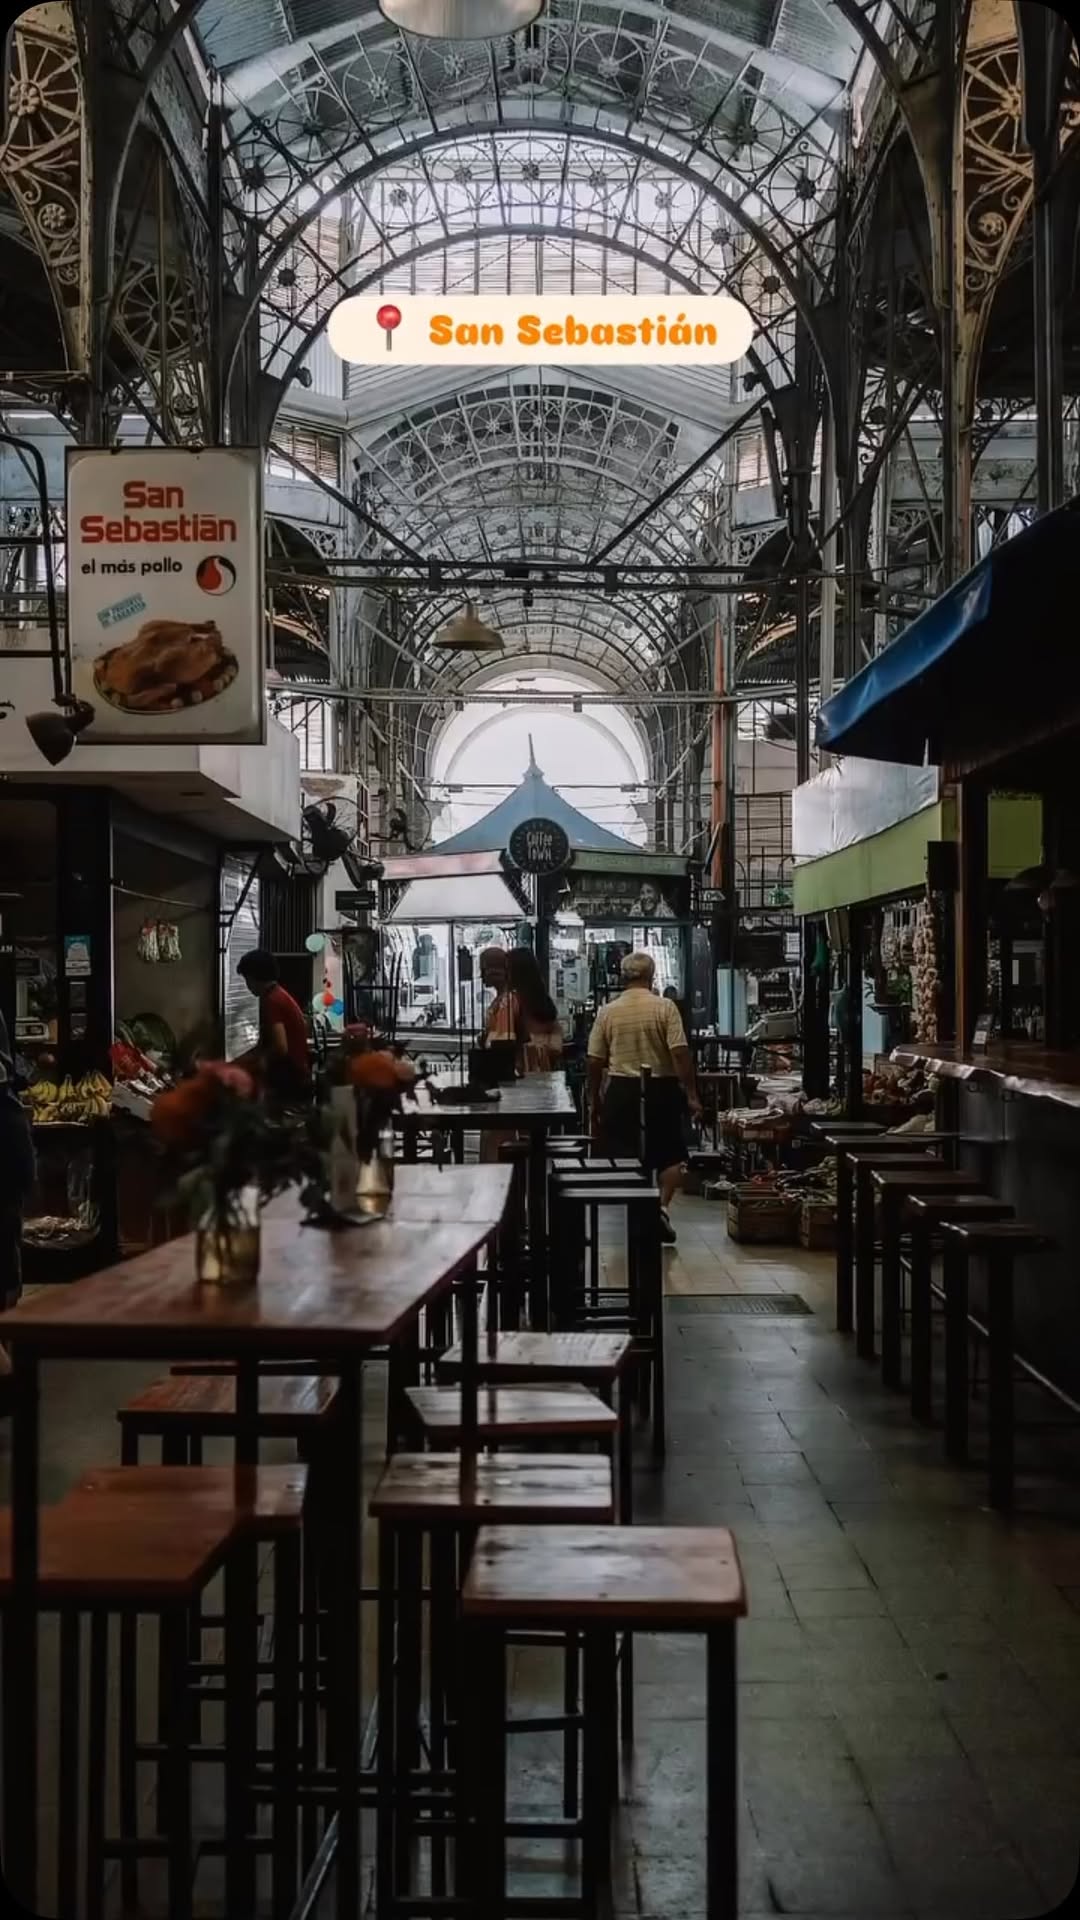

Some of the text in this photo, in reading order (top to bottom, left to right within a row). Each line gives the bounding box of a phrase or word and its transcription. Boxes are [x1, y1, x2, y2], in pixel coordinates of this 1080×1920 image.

[123, 480, 184, 509] San
[81, 556, 183, 576] el más pollo
